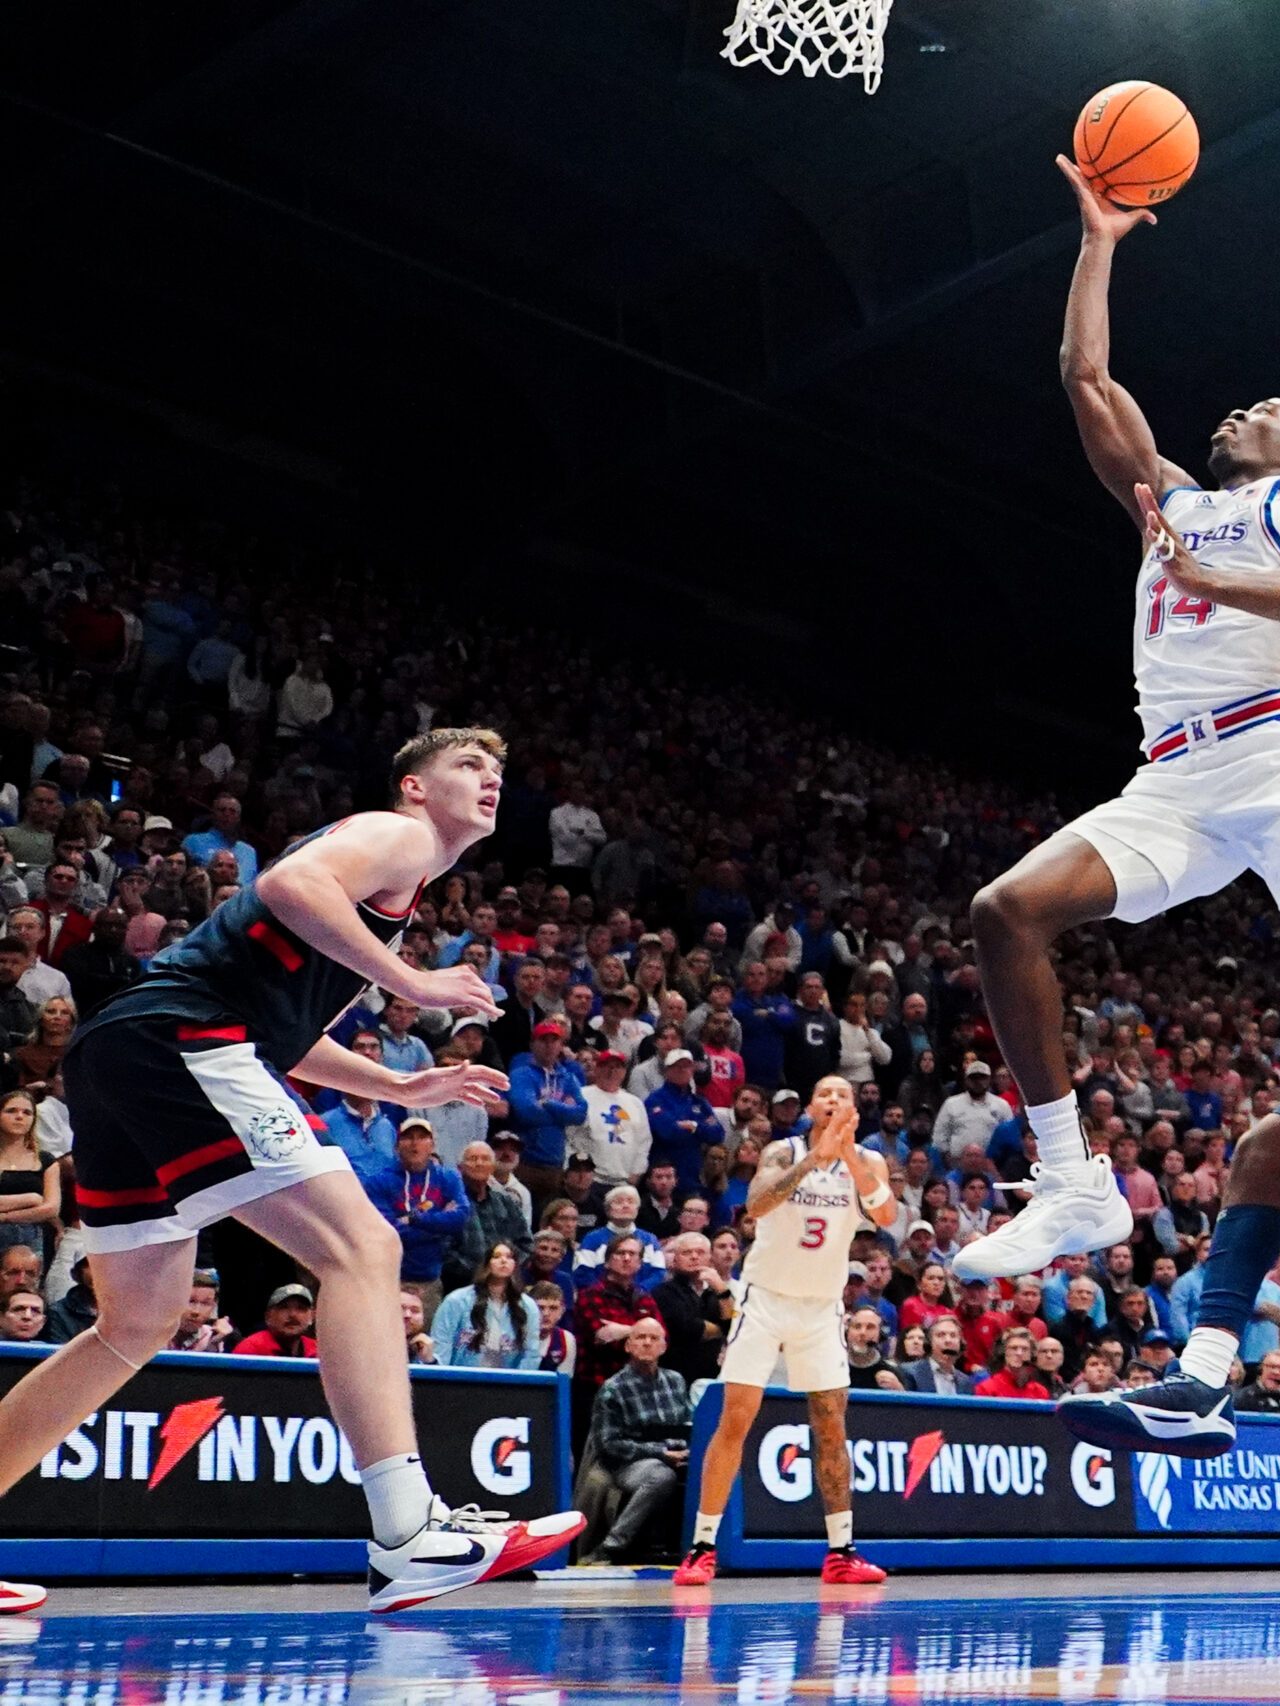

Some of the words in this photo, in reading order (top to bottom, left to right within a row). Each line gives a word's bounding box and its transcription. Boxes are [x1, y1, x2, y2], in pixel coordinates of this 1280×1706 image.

[1145, 575, 1217, 641] 14
[1191, 719, 1206, 741] K
[806, 1022, 825, 1046] C
[800, 1217, 826, 1248] 3
[104, 1410, 158, 1480] IT
[198, 1415, 256, 1481] IN
[471, 1416, 532, 1496] G
[758, 1423, 813, 1502] G
[878, 1440, 908, 1492] IT
[930, 1443, 965, 1494] IN
[965, 1444, 1047, 1496] YOU?
[1193, 1452, 1233, 1480] THE
[1070, 1440, 1117, 1508] G
[1192, 1479, 1273, 1512] KANSAS
